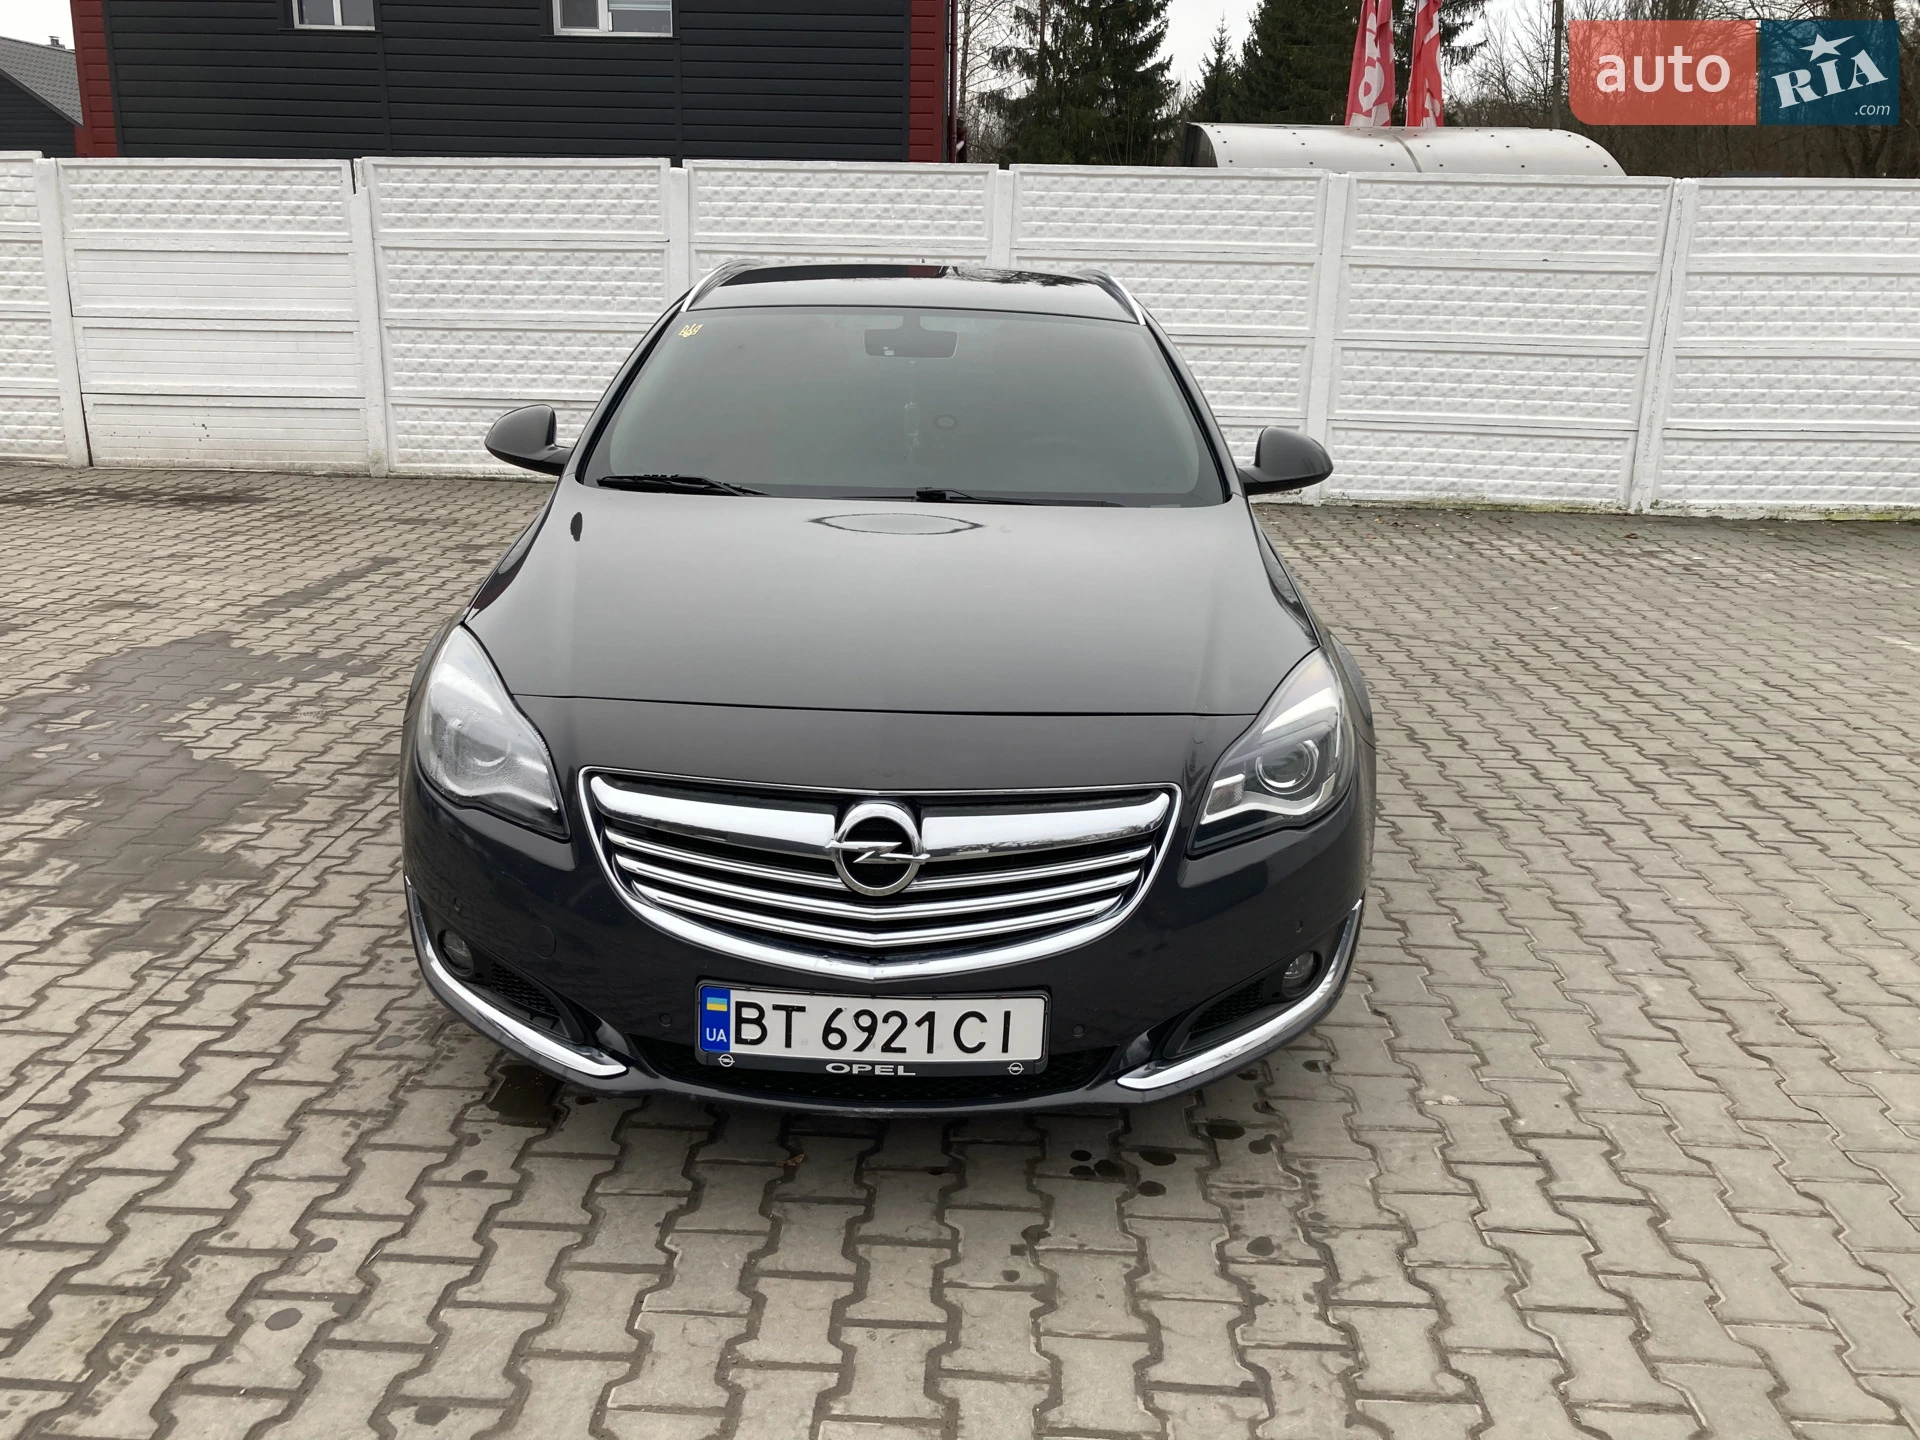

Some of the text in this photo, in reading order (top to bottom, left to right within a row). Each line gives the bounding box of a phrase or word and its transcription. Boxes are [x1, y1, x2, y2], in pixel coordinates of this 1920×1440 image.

[735, 1000, 1011, 1054] BT 6921 CI
[706, 1028, 727, 1042] UA
[825, 1062, 916, 1077] OPEL
